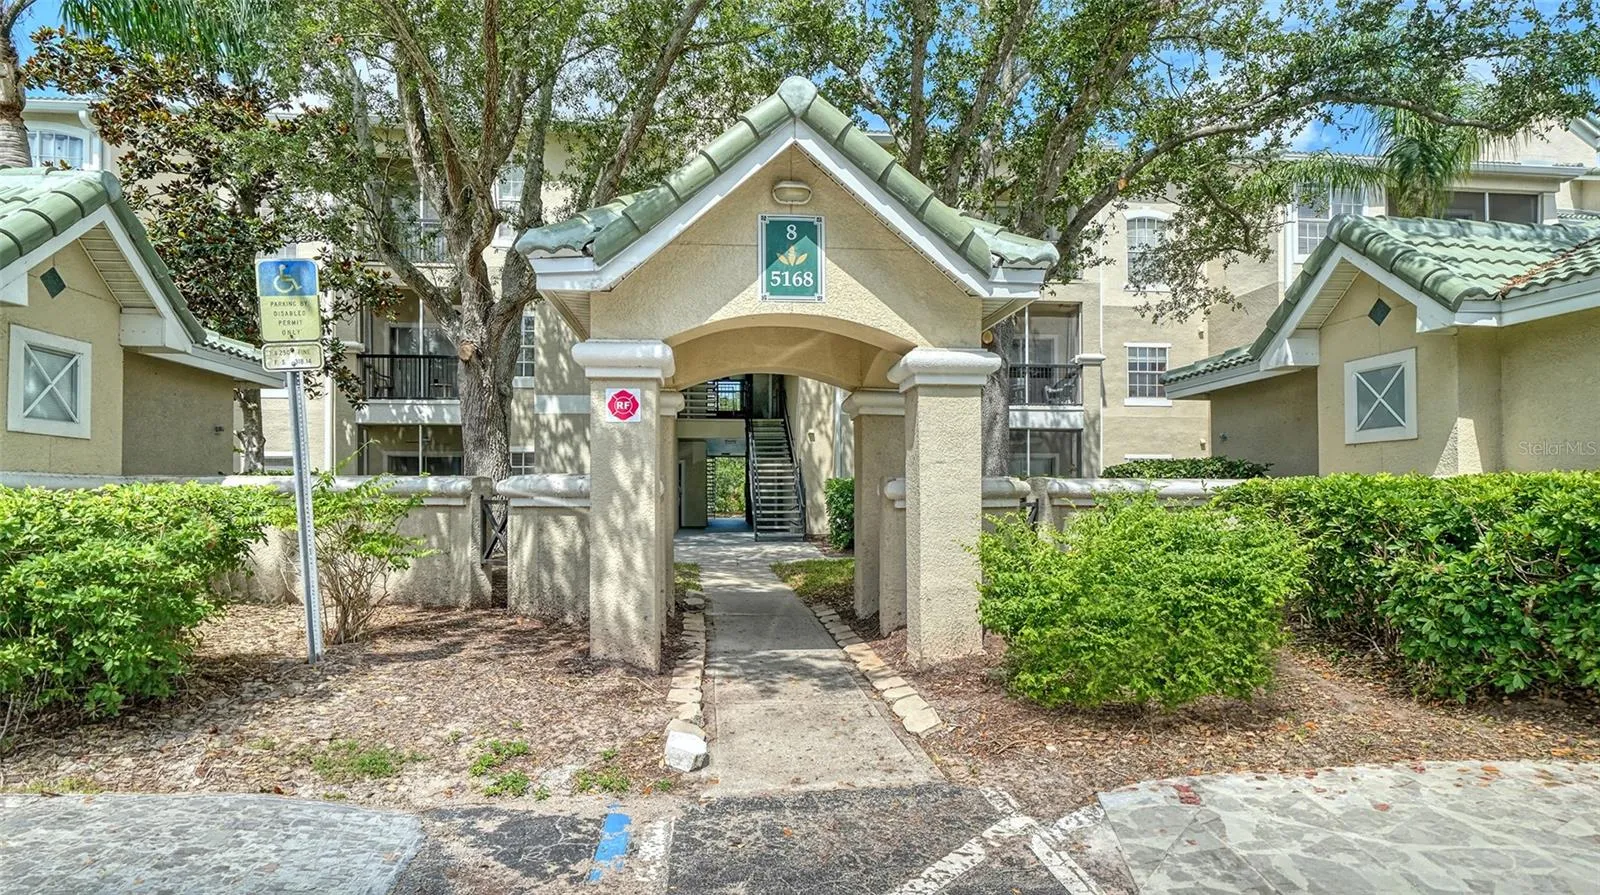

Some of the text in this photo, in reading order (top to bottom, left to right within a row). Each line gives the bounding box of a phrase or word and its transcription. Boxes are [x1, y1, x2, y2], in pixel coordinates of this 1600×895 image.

[786, 224, 798, 240] 8
[770, 270, 814, 287] 5168
[616, 401, 630, 410] RF
